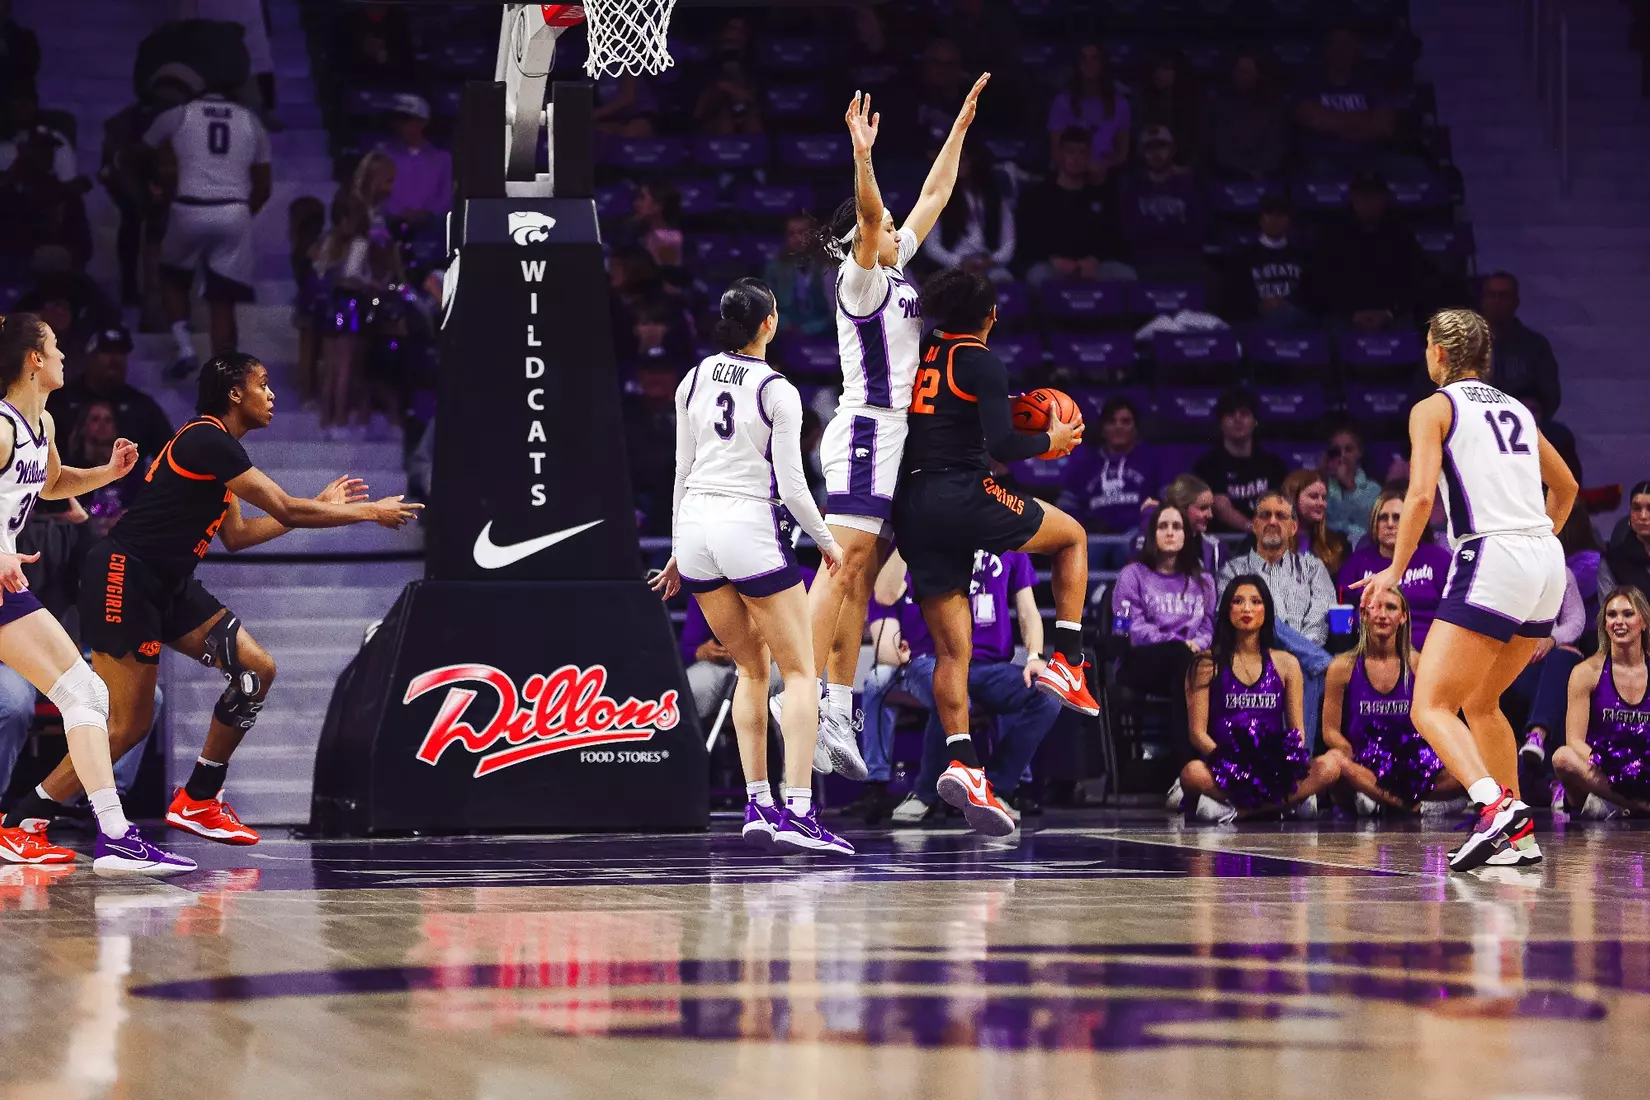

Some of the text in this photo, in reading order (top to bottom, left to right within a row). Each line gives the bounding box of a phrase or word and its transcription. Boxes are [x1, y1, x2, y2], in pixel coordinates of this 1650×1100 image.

[209, 121, 229, 154] 0
[520, 260, 548, 506] WILDCATS
[712, 363, 749, 386] GLENN
[1460, 386, 1511, 404] GREGORY
[714, 391, 735, 441] 3
[1484, 410, 1531, 455] 12
[105, 553, 126, 624] COWGIRLS
[402, 663, 680, 767] Dillons
[580, 751, 614, 763] FOOD
